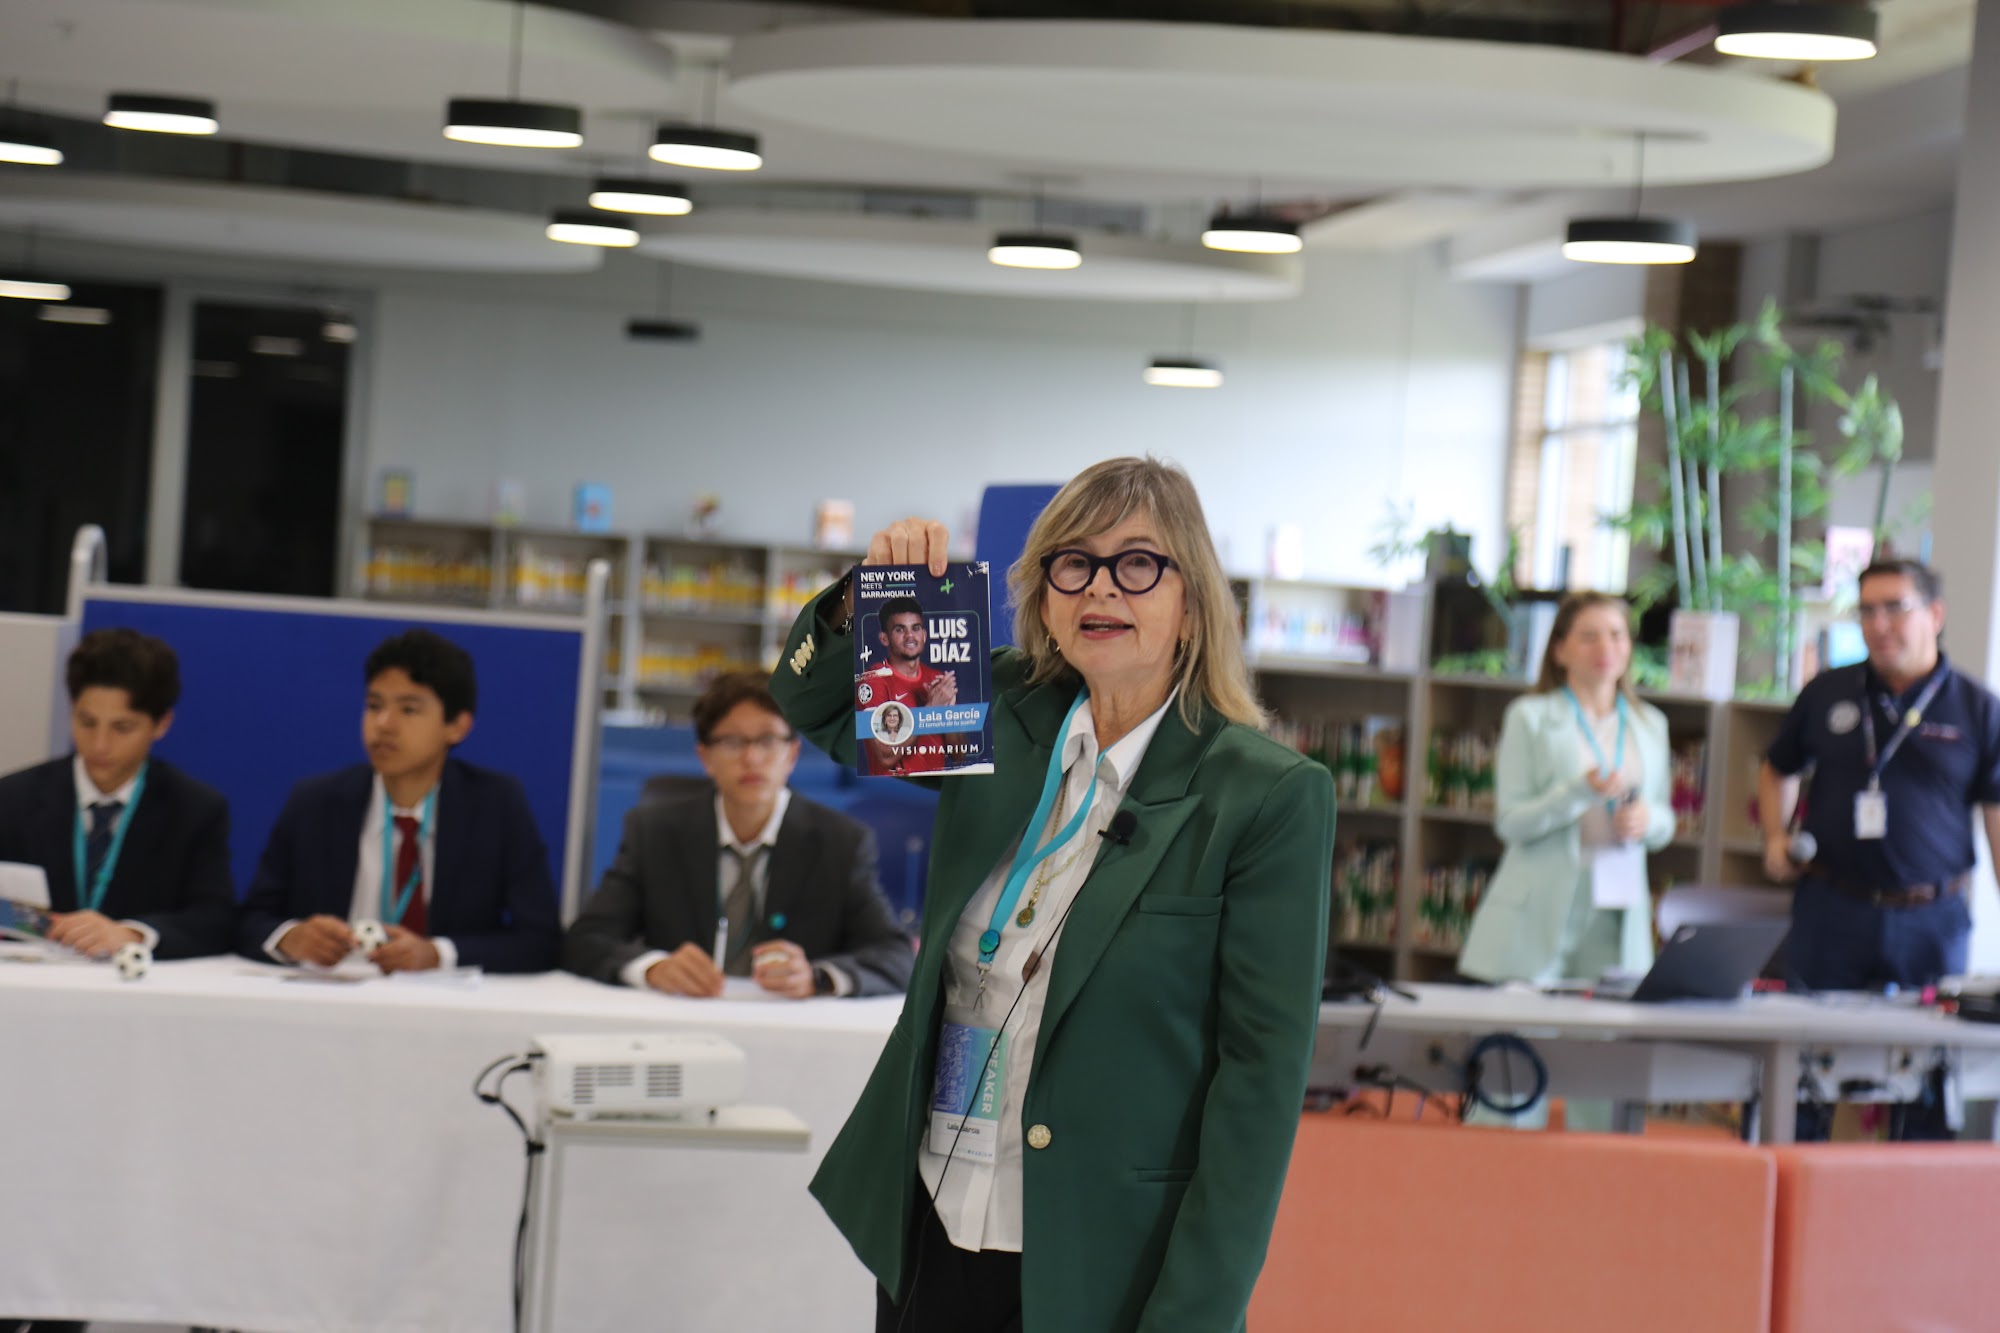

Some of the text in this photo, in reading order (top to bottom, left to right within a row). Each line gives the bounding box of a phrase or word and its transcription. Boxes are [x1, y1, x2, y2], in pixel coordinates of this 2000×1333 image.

[861, 571, 915, 582] NEW YORK
[861, 582, 883, 590] MEETS
[861, 590, 916, 598] BARRANQUILLA
[928, 618, 968, 639] LUIS
[929, 638, 971, 663] DÍAZ
[919, 708, 980, 721] Lala García
[891, 744, 979, 755] VISIONARIUM
[981, 1036, 1000, 1114] SPEAKER
